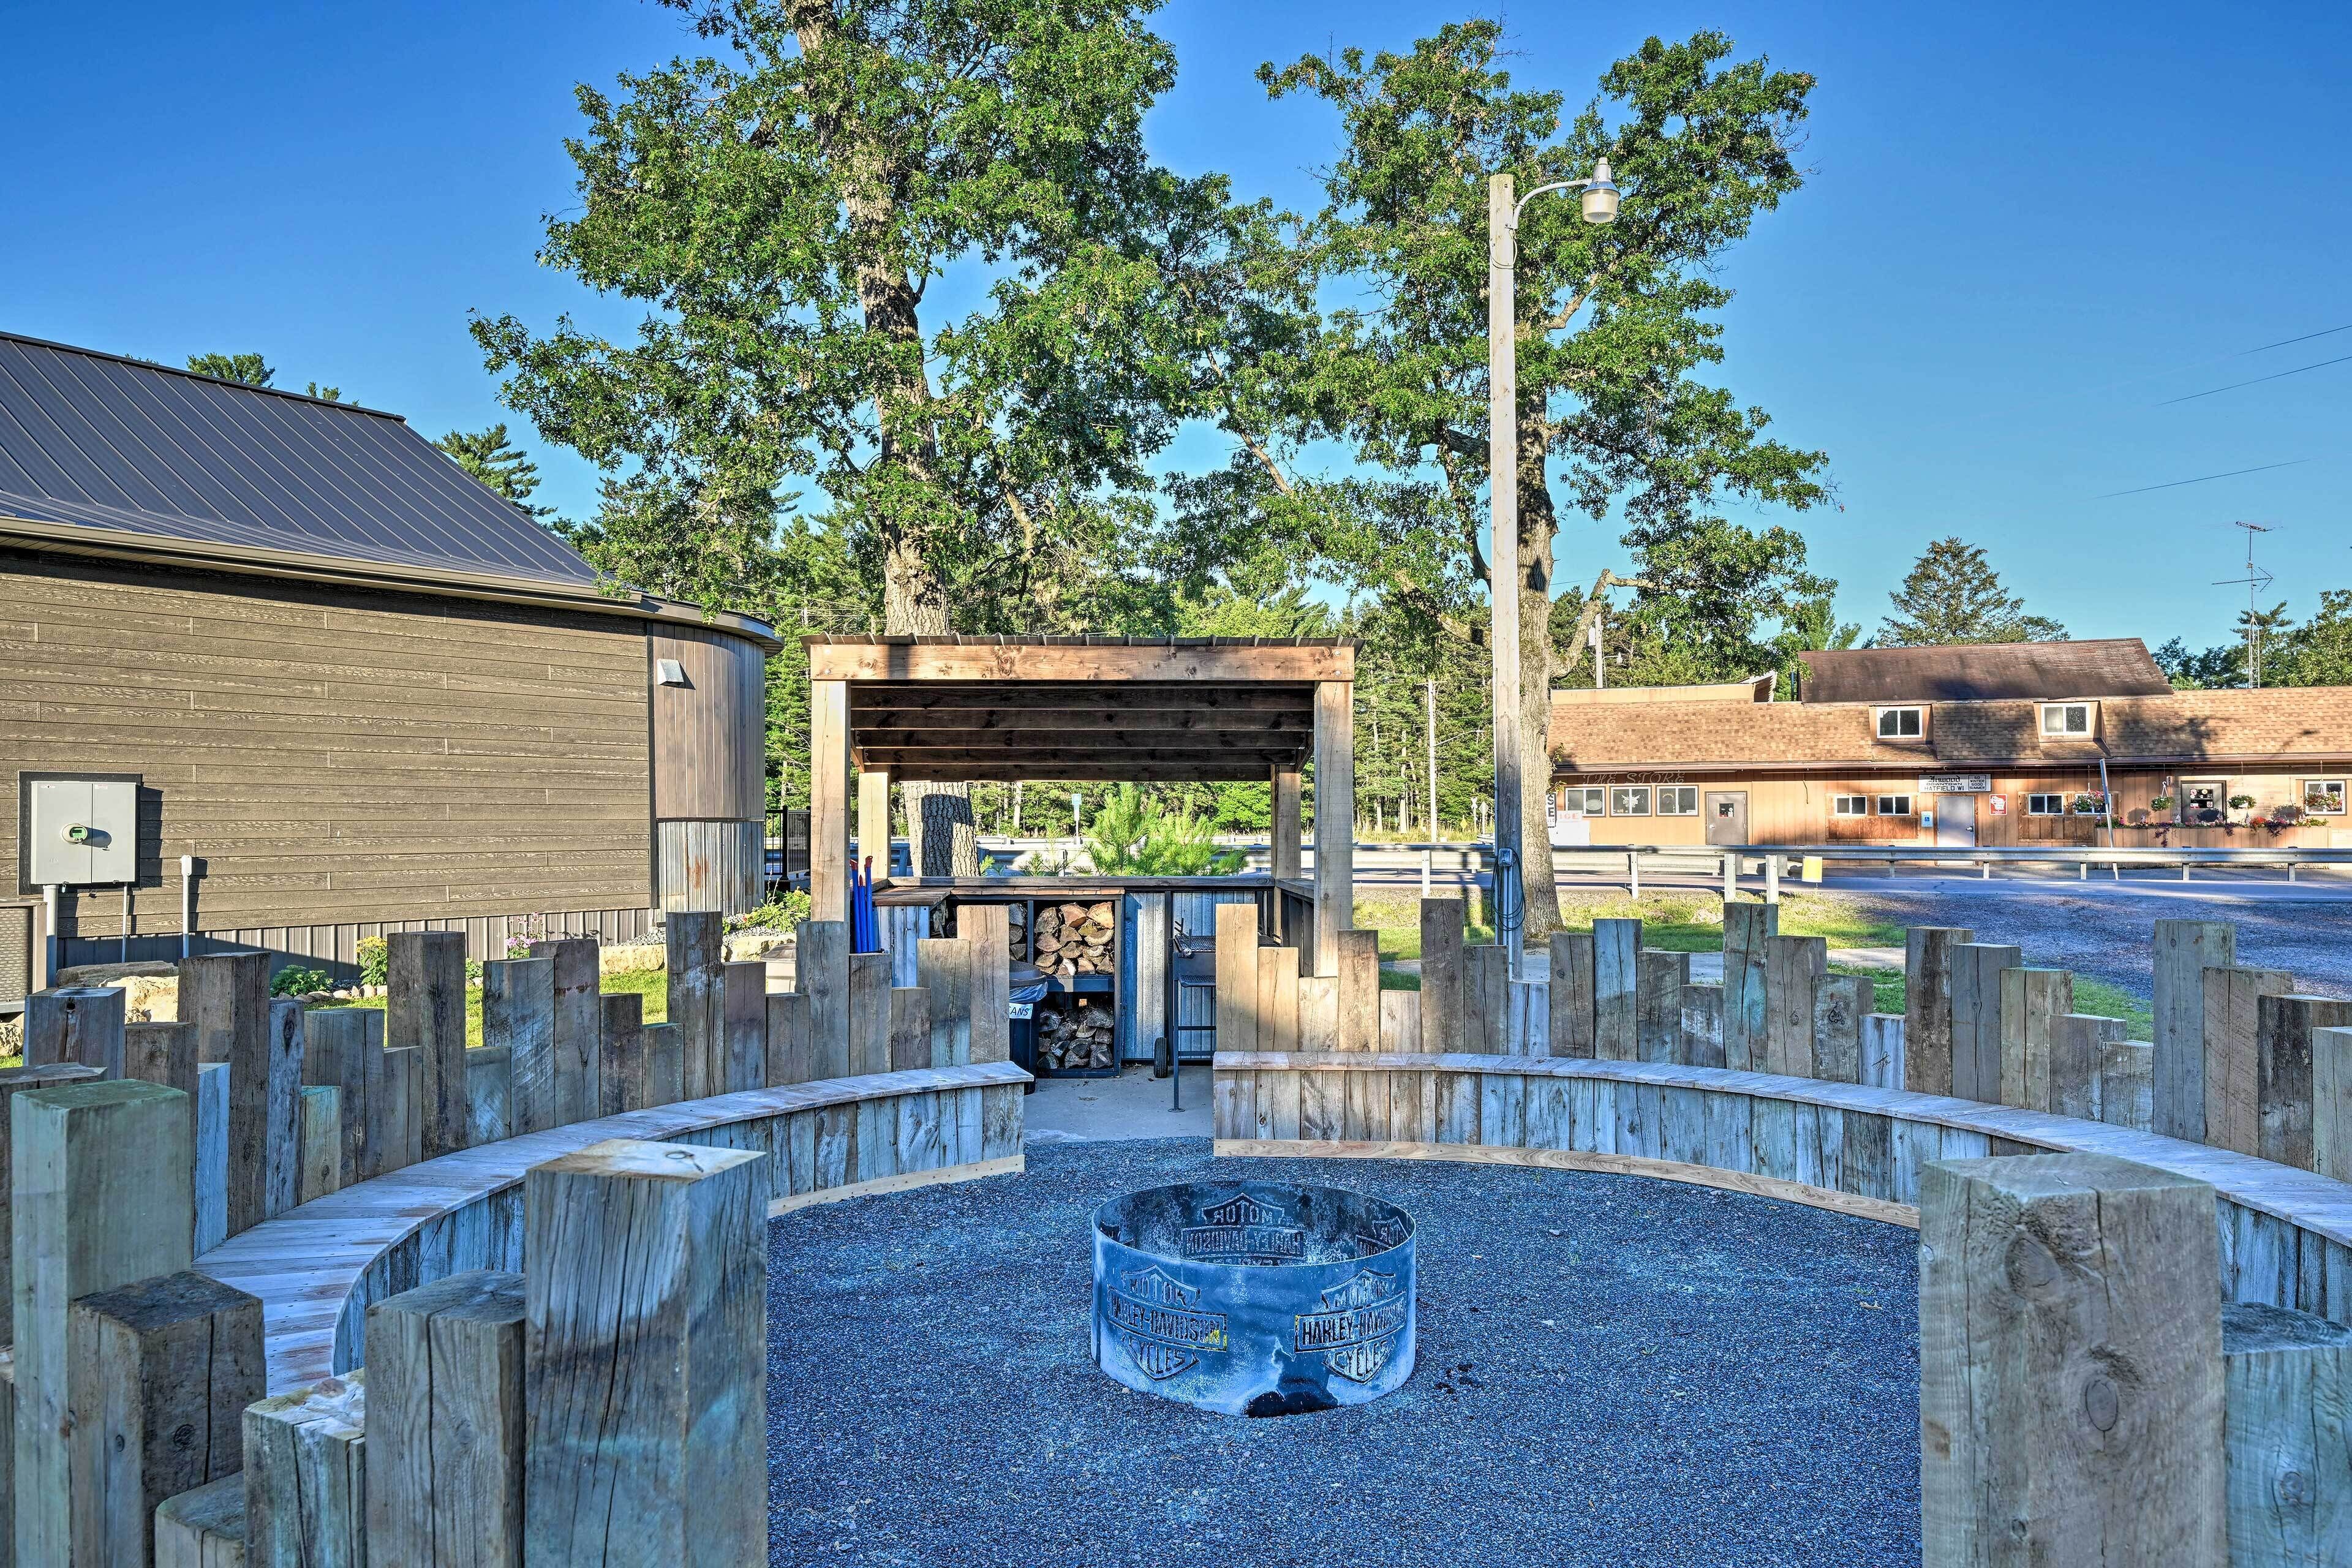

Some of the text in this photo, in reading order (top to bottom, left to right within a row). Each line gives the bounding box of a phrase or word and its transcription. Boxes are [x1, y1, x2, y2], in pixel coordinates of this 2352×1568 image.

[1582, 771, 1686, 785] THE STORE
[1009, 1006, 1031, 1016] ANS
[1129, 1273, 1187, 1306] MOTOR
